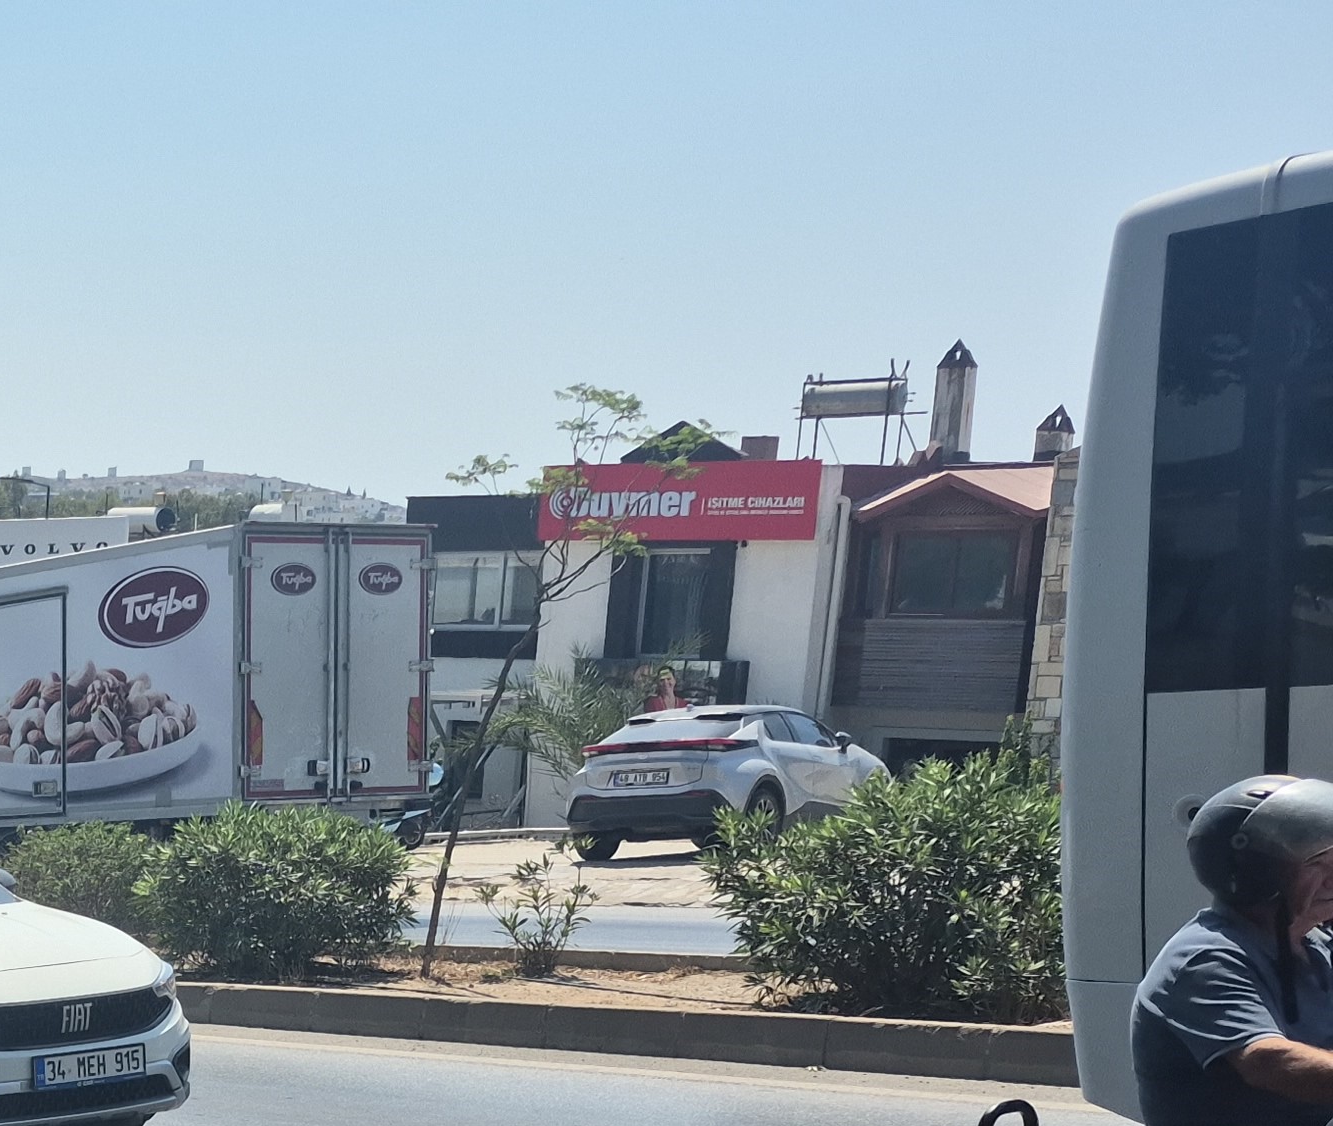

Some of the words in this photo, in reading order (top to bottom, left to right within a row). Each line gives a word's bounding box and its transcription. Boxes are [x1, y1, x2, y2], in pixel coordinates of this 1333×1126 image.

[60, 1002, 93, 1034] FIAT
[46, 1060, 66, 1082] 34
[76, 1054, 106, 1078] MEH
[114, 1049, 140, 1072] 915
